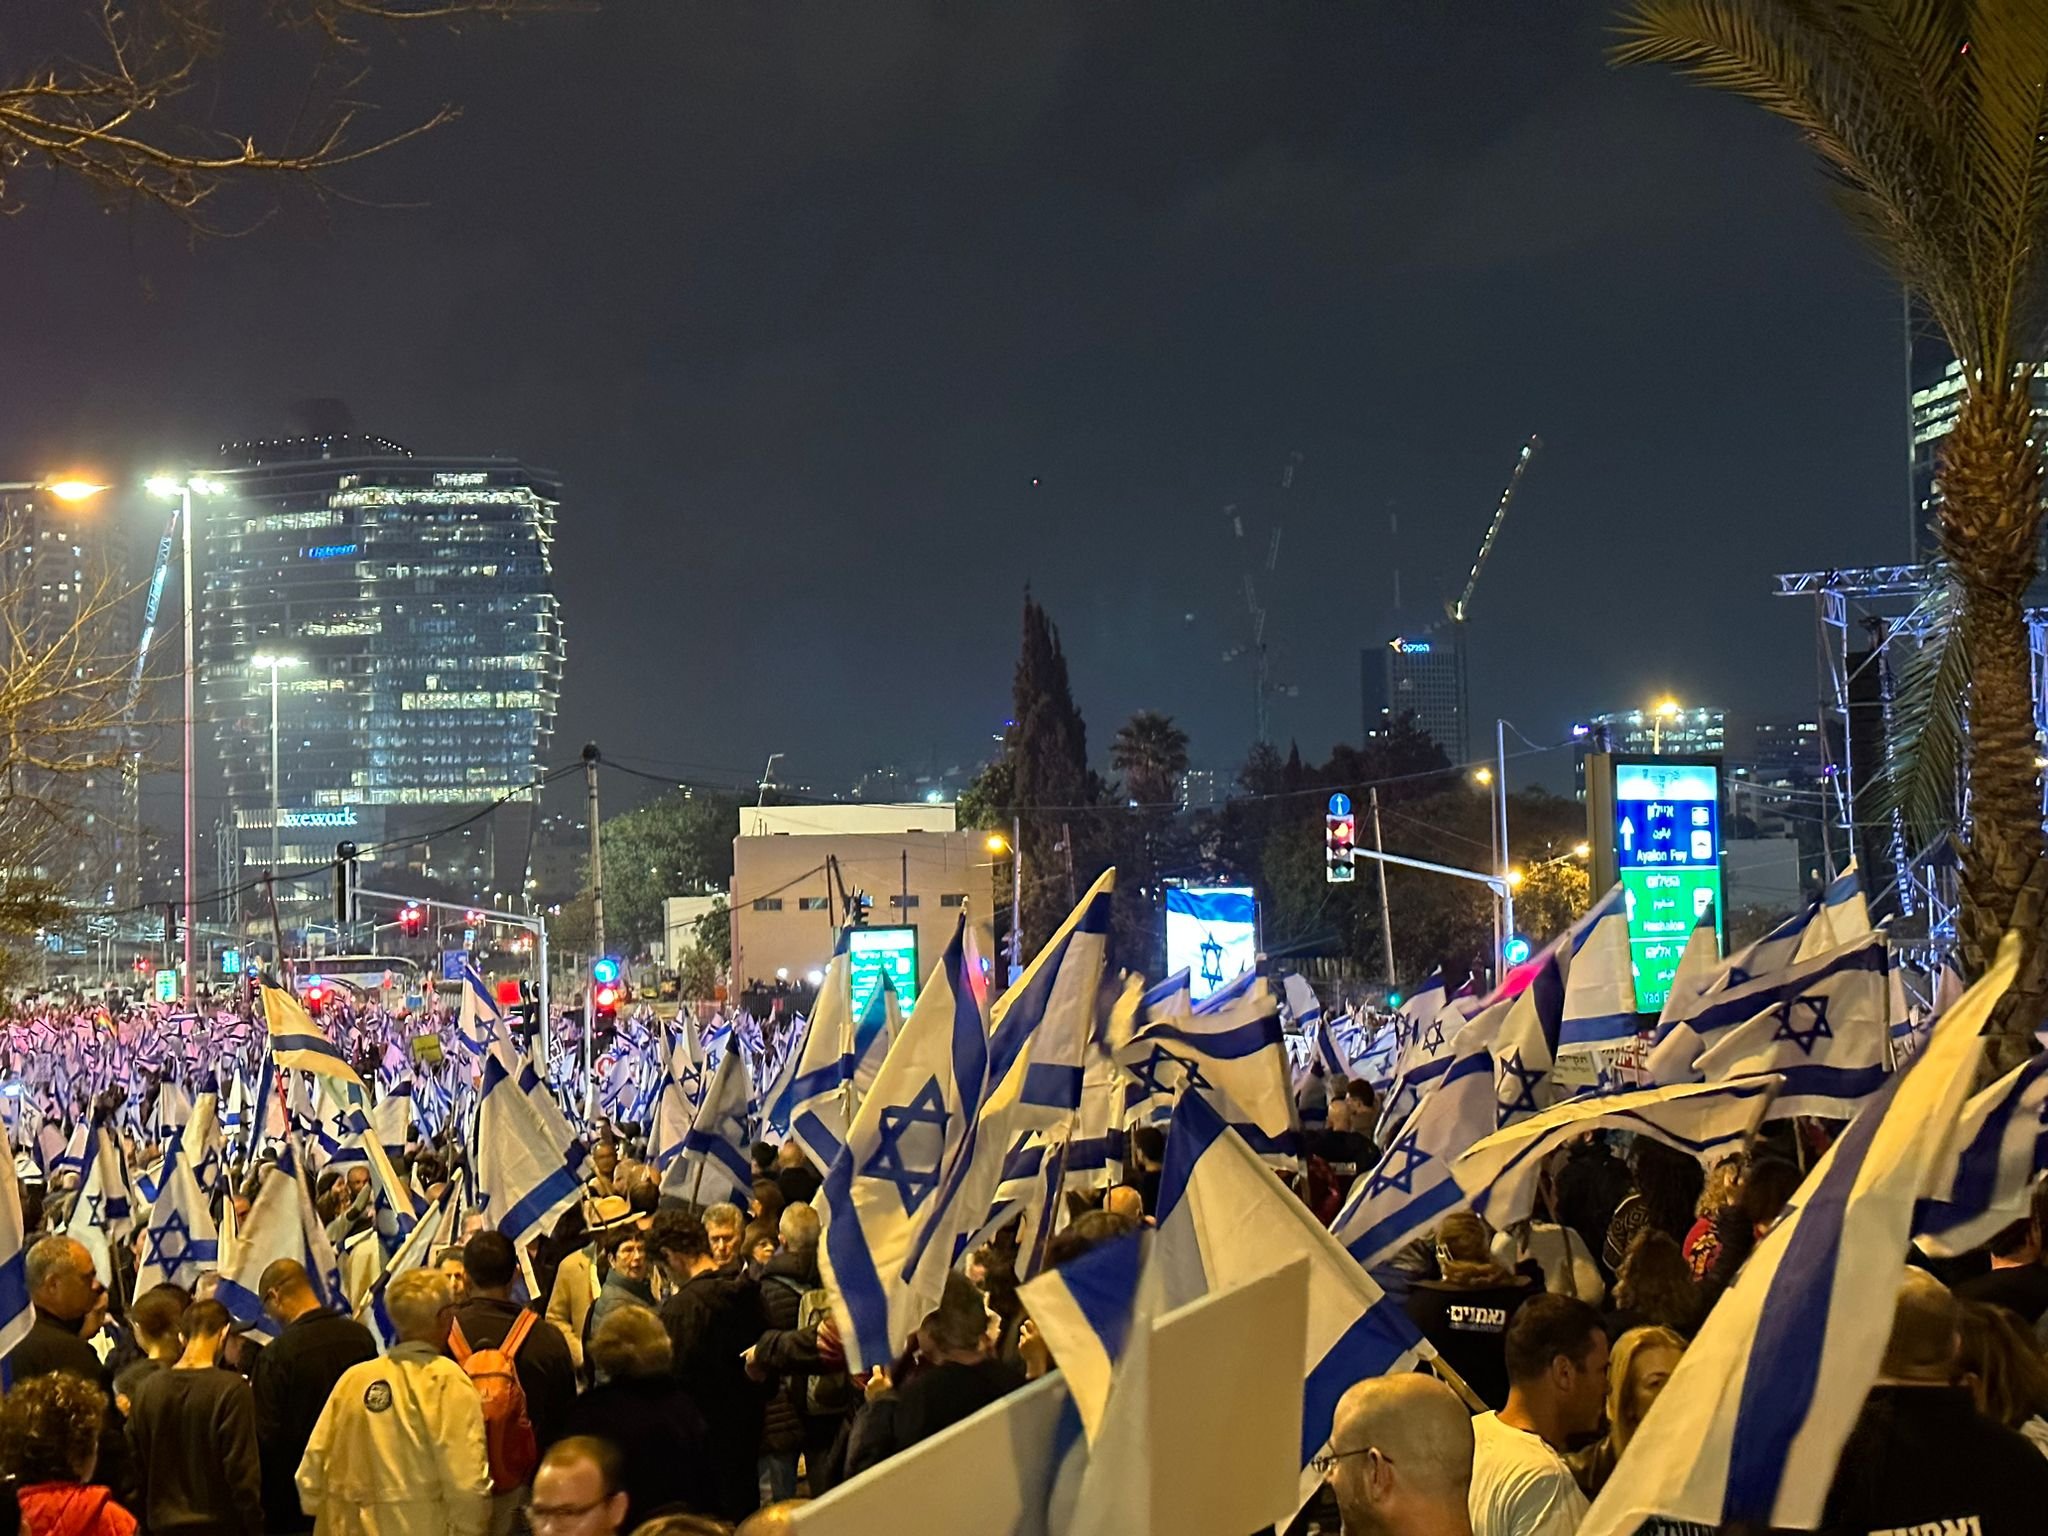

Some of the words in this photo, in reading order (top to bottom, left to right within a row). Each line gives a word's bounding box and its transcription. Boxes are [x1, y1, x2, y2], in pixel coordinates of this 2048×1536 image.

[284, 806, 358, 827] wework
[1647, 802, 1674, 820] איילון
[1637, 848, 1667, 865] Ayalon
[1643, 992, 1660, 1004] Yad
[1450, 1305, 1506, 1325] נאמנים
